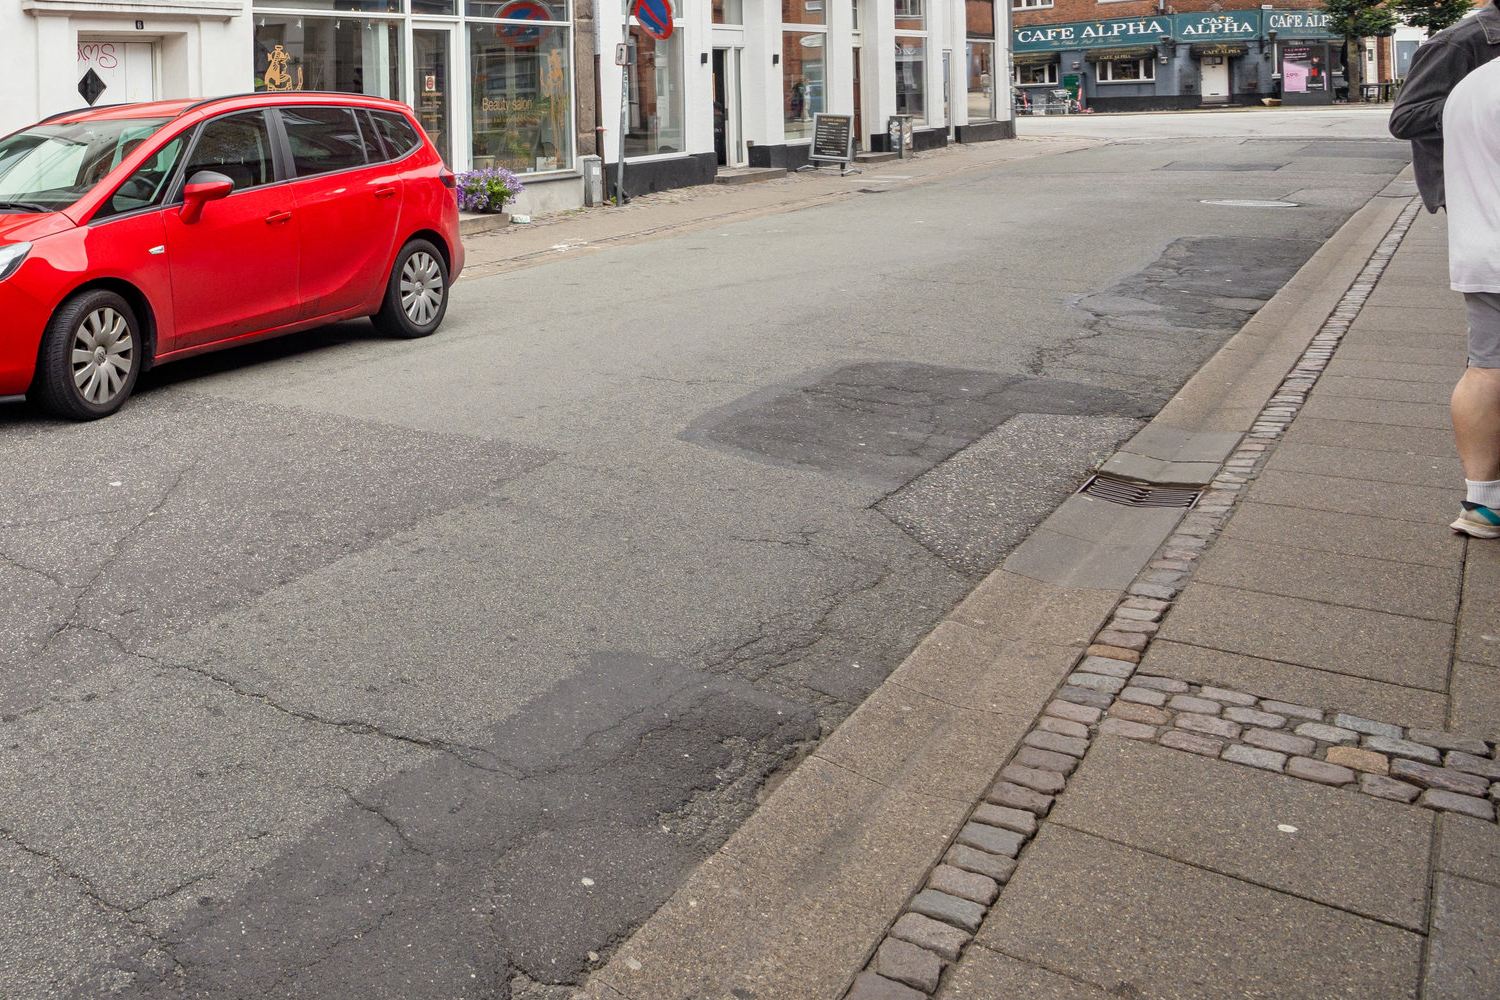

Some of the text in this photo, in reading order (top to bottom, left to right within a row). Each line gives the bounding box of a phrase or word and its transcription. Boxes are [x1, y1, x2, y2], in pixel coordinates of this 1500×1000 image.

[1201, 16, 1234, 25] CAFE
[1270, 13, 1333, 28] CAFE ALP
[1018, 21, 1163, 43] CAFE ALPHA
[1182, 22, 1254, 35] ALPHA
[482, 97, 533, 112] Beauty salon
